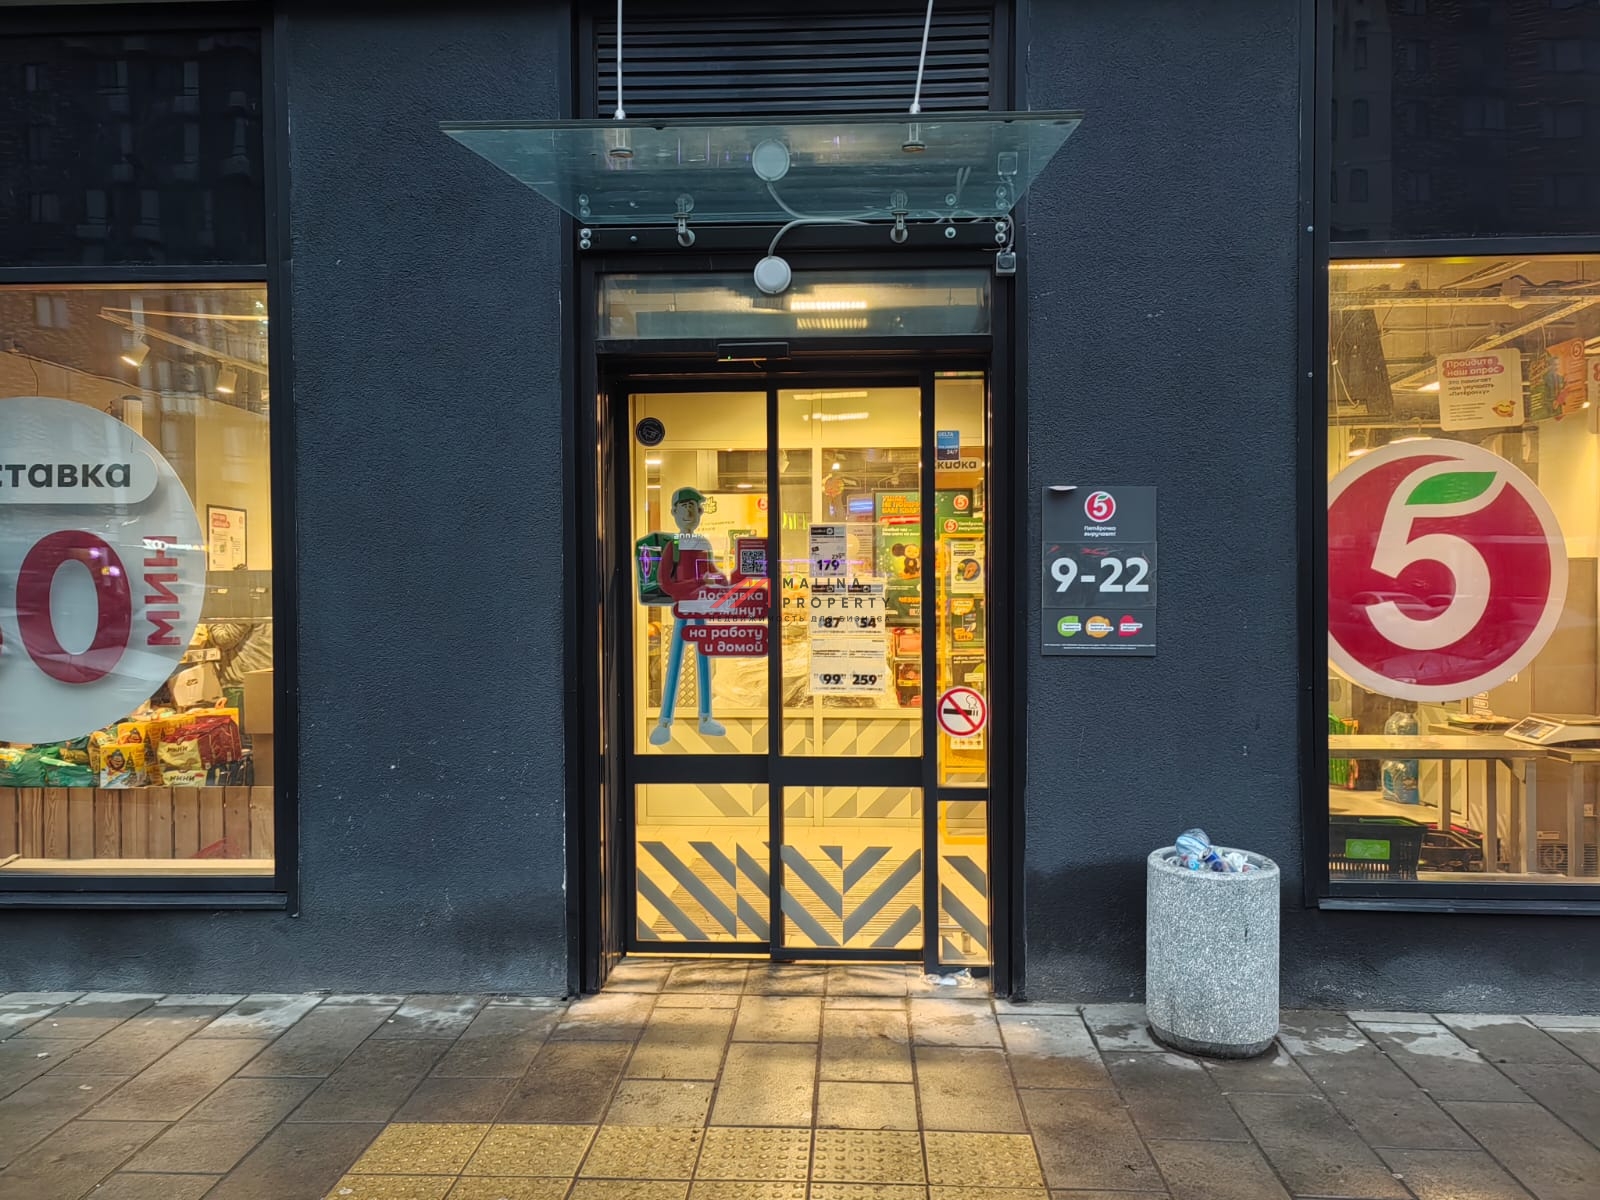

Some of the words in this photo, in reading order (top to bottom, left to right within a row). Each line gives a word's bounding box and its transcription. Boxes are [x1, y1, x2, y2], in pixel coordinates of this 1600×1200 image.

[937, 461, 977, 469] кидка
[0, 463, 131, 488] тавка
[1092, 495, 1109, 517] 5
[817, 559, 840, 571] 179
[1366, 462, 1506, 650] 5
[1051, 557, 1149, 592] 9-22
[0, 530, 132, 684] 0
[689, 629, 707, 638] на
[711, 626, 763, 640] работу
[705, 643, 713, 652] и
[717, 641, 763, 652] домой
[852, 674, 877, 685] 259
